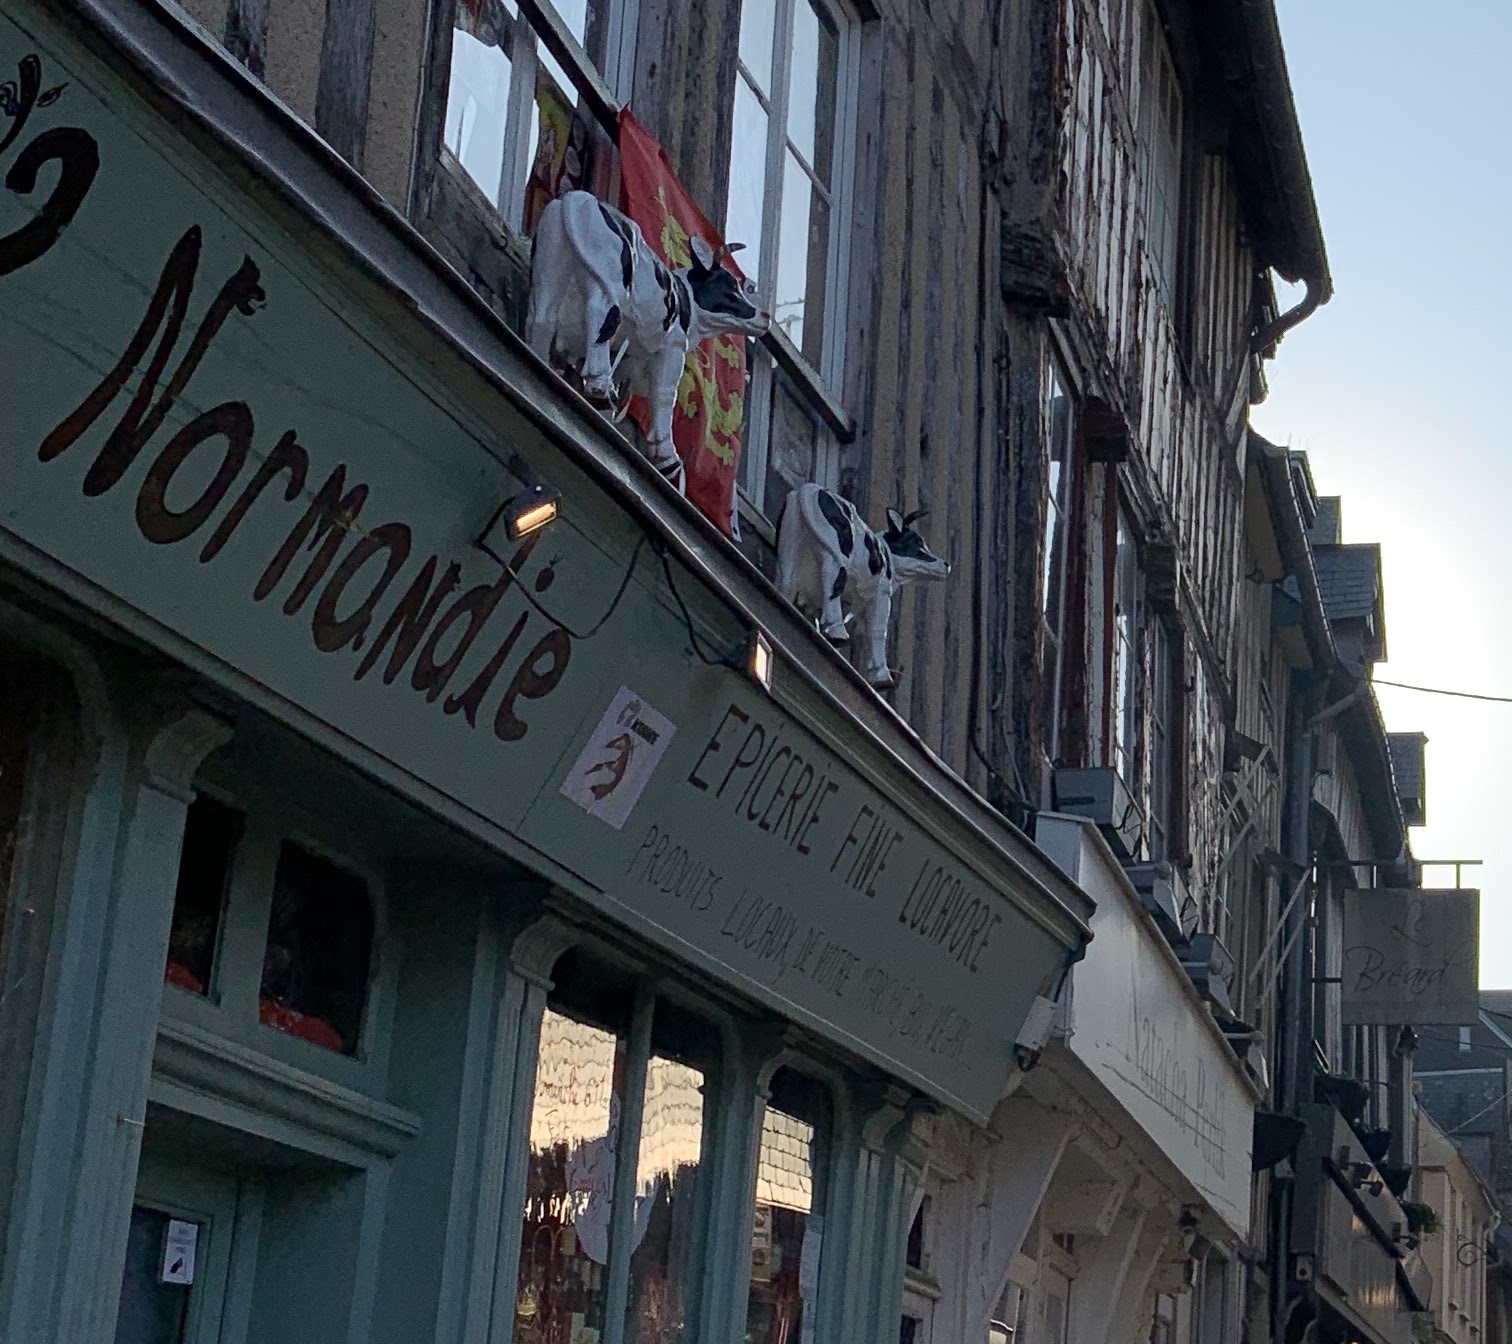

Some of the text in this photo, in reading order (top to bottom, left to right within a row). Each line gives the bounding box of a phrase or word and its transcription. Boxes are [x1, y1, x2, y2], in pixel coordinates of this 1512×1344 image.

[38, 224, 572, 741] Normandie
[625, 824, 723, 912] PRODUITS
[829, 803, 903, 899] FINE
[898, 858, 1002, 974] LOCAVORE
